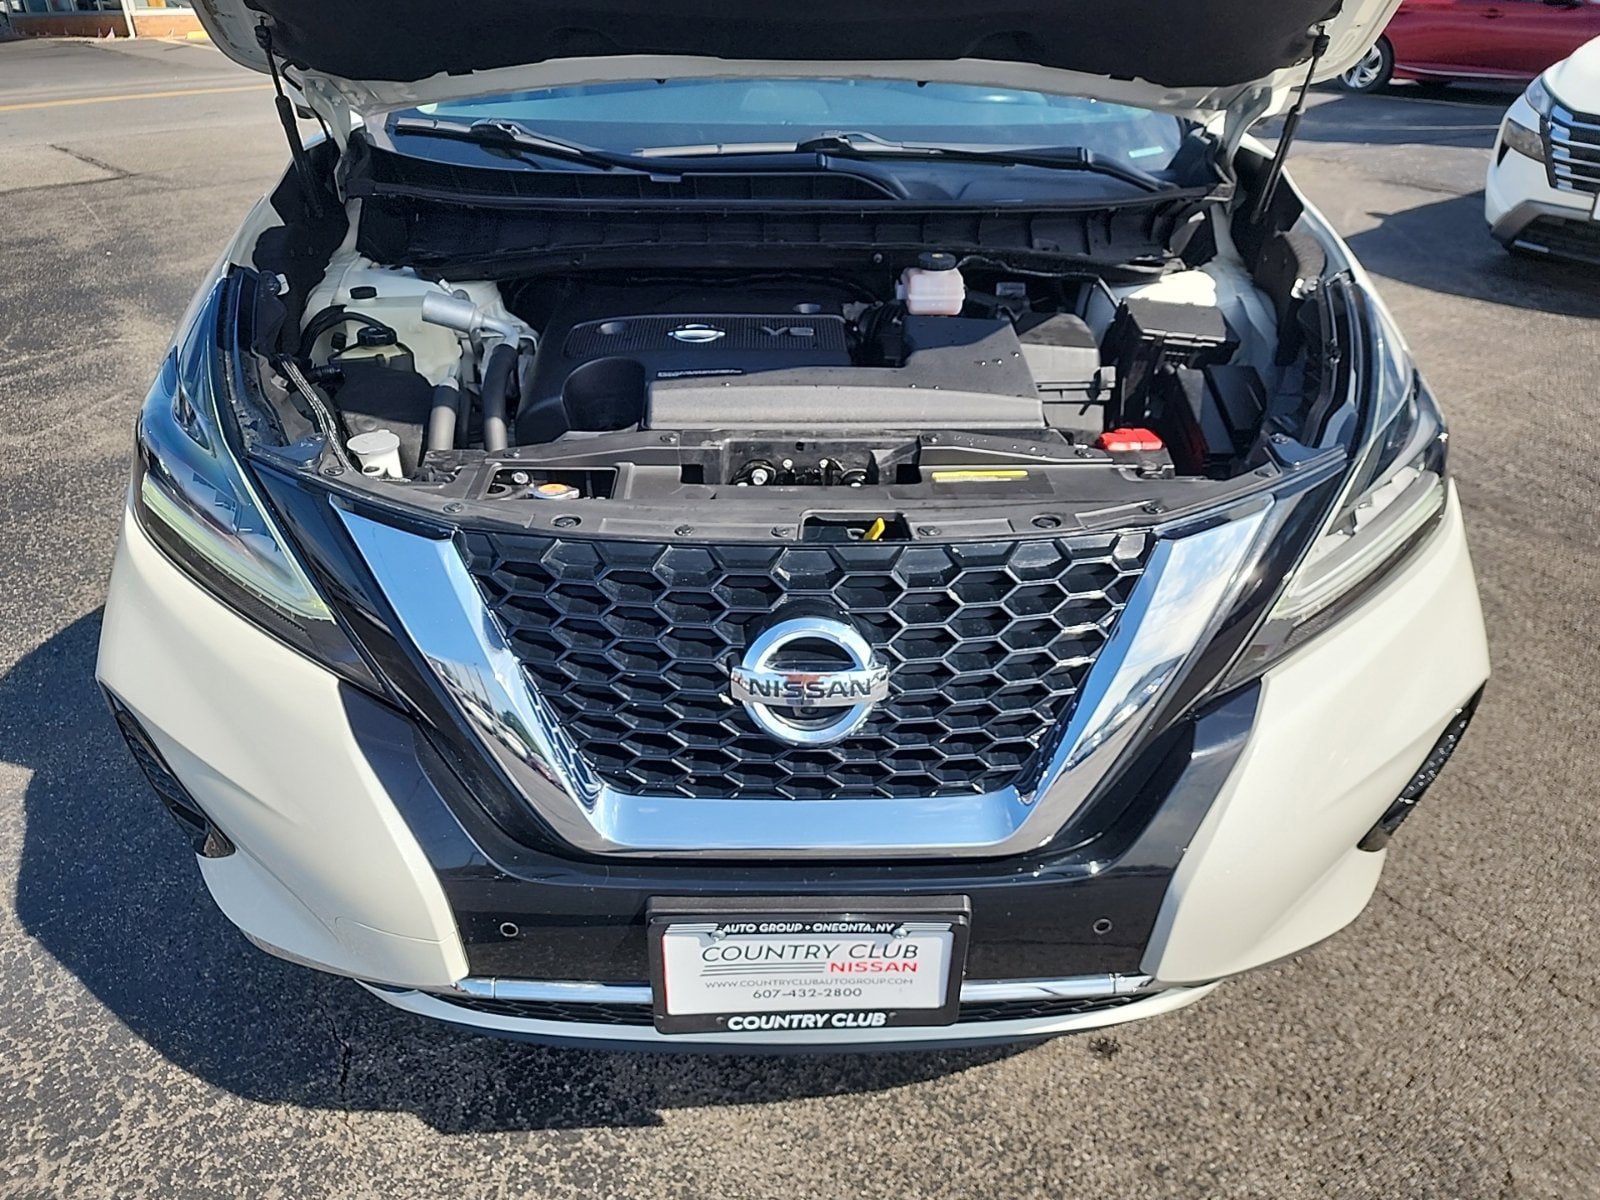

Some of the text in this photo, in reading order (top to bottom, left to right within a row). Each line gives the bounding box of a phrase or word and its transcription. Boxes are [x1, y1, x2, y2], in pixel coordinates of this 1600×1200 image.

[750, 678, 871, 698] NISSAN
[722, 923, 757, 933] AUTO
[759, 923, 803, 933] GROUP
[702, 944, 918, 962] COUNTRY CLUB
[830, 962, 918, 973] NISSAN
[753, 988, 862, 998] 607-432-2800
[727, 1012, 887, 1030] COUNTRY CLUB
